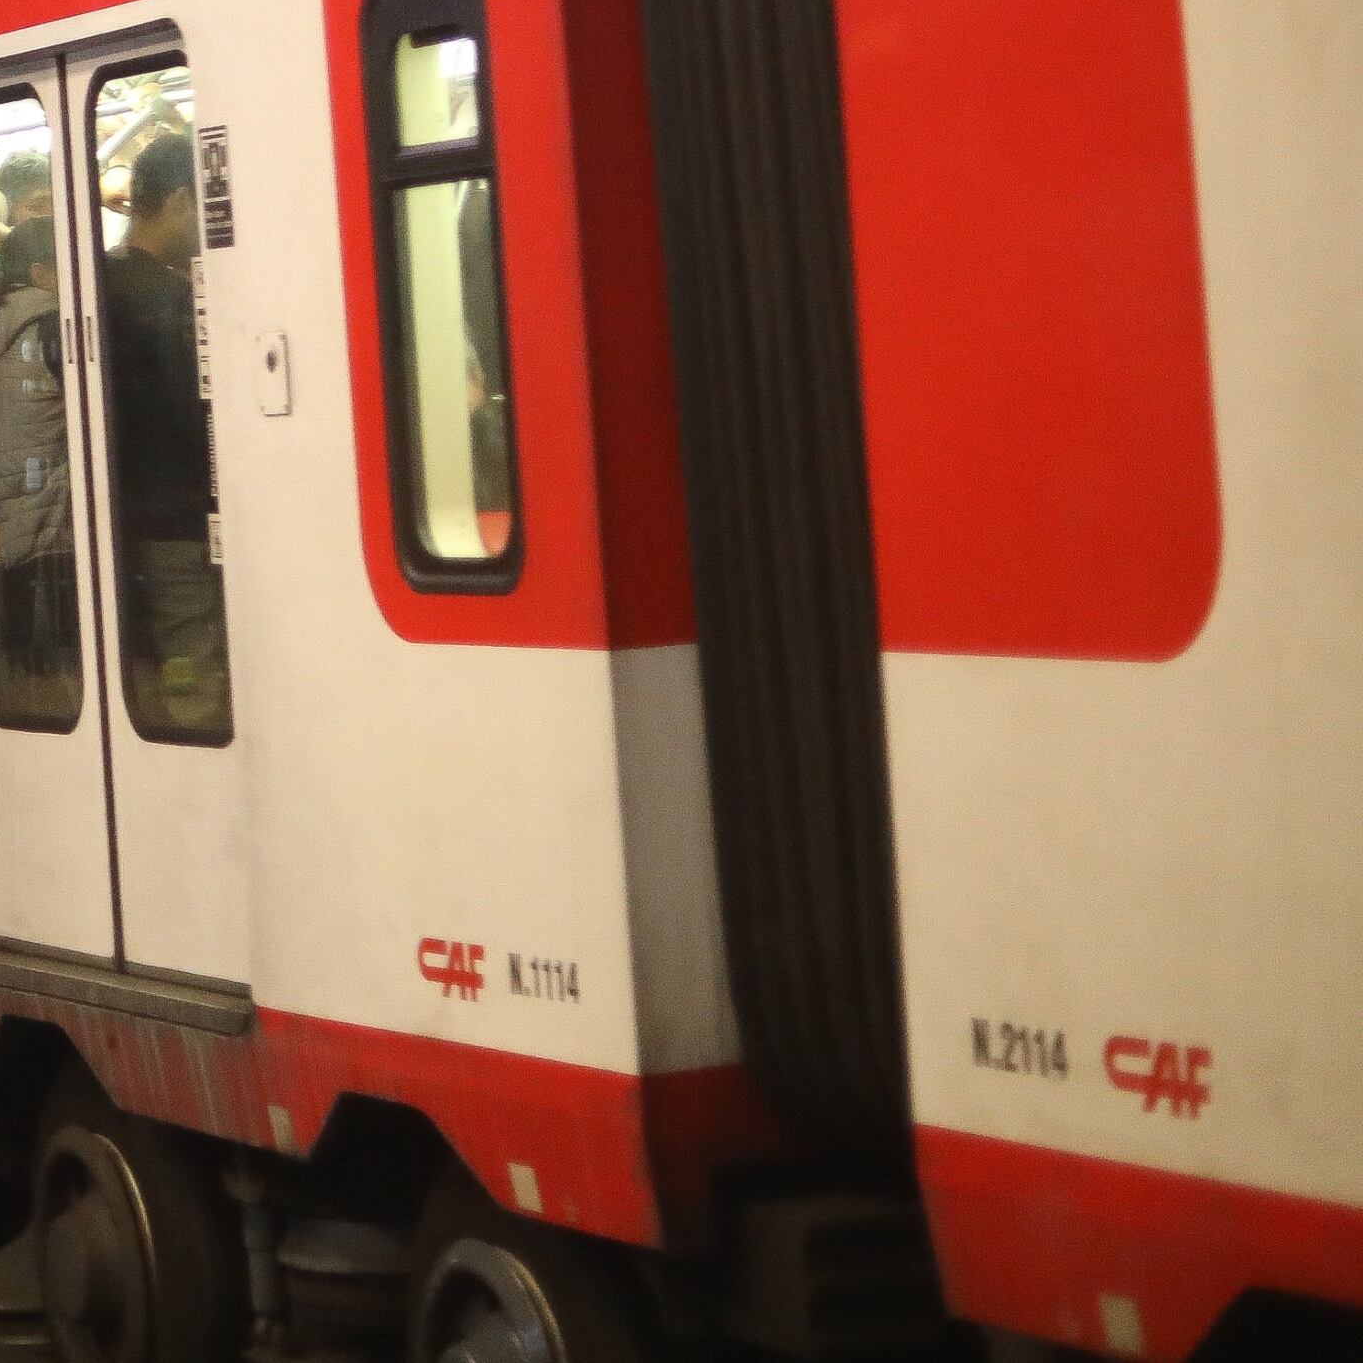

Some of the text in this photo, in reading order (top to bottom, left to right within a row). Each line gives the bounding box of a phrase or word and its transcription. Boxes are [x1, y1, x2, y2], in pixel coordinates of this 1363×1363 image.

[417, 937, 486, 1003] CAF
[506, 951, 580, 1005] N.1114
[971, 1017, 1071, 1079] N.2114
[1103, 1035, 1212, 1120] CAF
